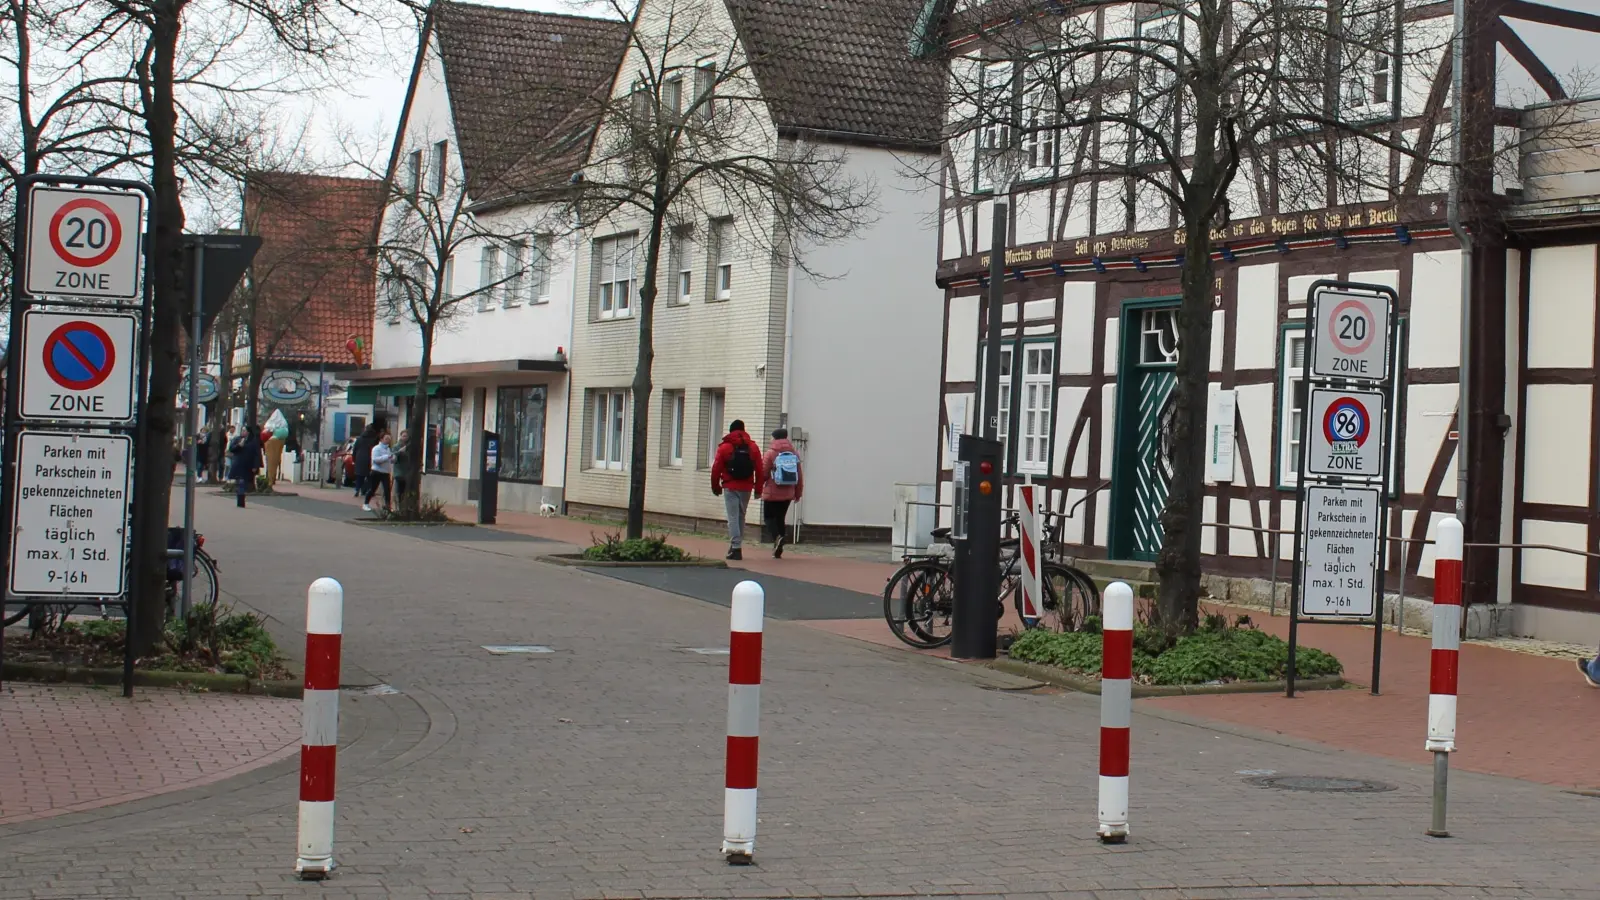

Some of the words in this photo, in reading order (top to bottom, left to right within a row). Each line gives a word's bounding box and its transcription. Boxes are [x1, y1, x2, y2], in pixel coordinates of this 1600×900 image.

[1271, 216, 1297, 235] Segen
[1368, 205, 1399, 226] Beruf
[65, 217, 106, 249] 20
[55, 271, 110, 290] ZONE
[1339, 314, 1366, 341] 20
[1332, 357, 1368, 373] ZONE
[49, 394, 104, 412] ZONE
[1337, 412, 1356, 434] 96
[488, 440, 496, 449] P
[44, 445, 82, 459] Parken
[87, 447, 106, 460] mit
[1327, 455, 1362, 470] ZONE
[35, 464, 96, 479] Parkschein
[101, 467, 112, 480] in
[22, 484, 122, 500] gekennzeichneten
[1323, 495, 1347, 507] Parken
[1350, 497, 1363, 508] mit
[50, 504, 93, 518] Flächen
[1317, 511, 1357, 523] Parkschein
[1359, 513, 1367, 523] in
[45, 527, 95, 543] täglich
[1309, 527, 1374, 540] gekennzeichneten
[27, 549, 62, 560] max.
[70, 547, 75, 560] 1
[82, 547, 110, 561] Std.
[1327, 543, 1355, 554] Flächen
[1324, 561, 1356, 575] täglich
[1312, 579, 1335, 588] max.
[1339, 578, 1343, 588] 1
[1347, 578, 1366, 589] Std.
